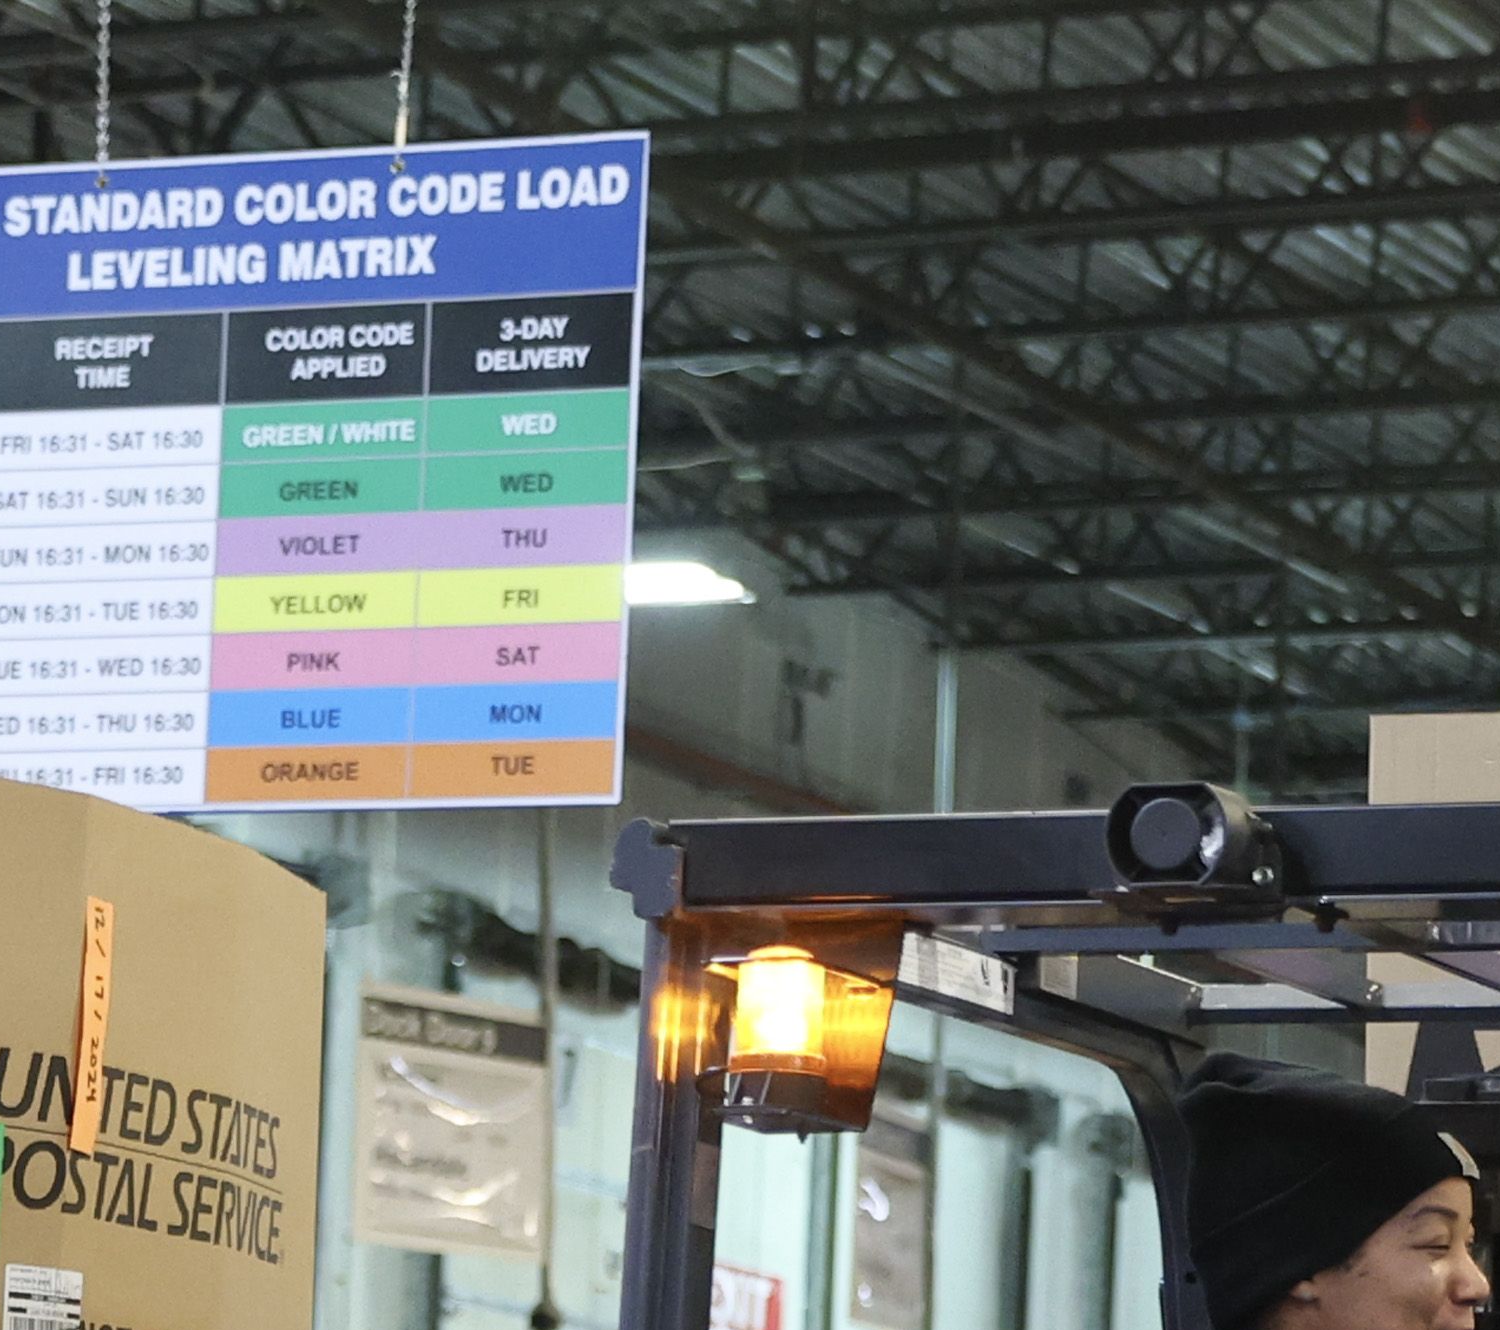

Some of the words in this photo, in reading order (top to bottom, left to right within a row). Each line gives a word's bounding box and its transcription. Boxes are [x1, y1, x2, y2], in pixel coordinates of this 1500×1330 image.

[2, 188, 224, 237] STANDARD
[234, 179, 377, 226] COLOR
[388, 171, 505, 217] CODE
[516, 164, 630, 210] LOAD
[65, 243, 267, 292] LEVELING
[278, 234, 437, 282] MATRIX
[265, 326, 344, 352] COLOR
[349, 323, 414, 348] CODE
[499, 316, 570, 342] 3-DAY
[54, 335, 154, 361] RECEIPT
[475, 346, 591, 373] DELIVERY
[74, 365, 131, 389] TIME
[290, 354, 386, 381] APPLIED
[242, 425, 324, 449] GREEN
[342, 419, 416, 445] WHITE
[501, 413, 557, 436] WED
[0, 435, 31, 455] FRI
[39, 433, 87, 454] 16:31
[107, 431, 144, 451] SAT
[153, 429, 203, 450] 16:30
[278, 480, 359, 502] GREEN
[500, 473, 554, 494] WED
[37, 490, 85, 510] 16:31
[105, 488, 146, 507] SUN
[154, 486, 204, 506] 16:30
[279, 534, 360, 557] VIOLET
[501, 528, 548, 549] THU
[36, 546, 84, 566] 16:31
[104, 545, 151, 564] MON
[159, 543, 209, 562] 16:30
[270, 593, 367, 615] YELLOW
[503, 588, 540, 609] FRI
[33, 604, 81, 622] 16:31
[101, 602, 139, 621] TUE
[148, 601, 198, 619] 16:30
[30, 660, 78, 679] 16:31
[98, 658, 143, 678] WED
[152, 656, 202, 676] 16:30
[286, 652, 341, 672] PINK
[496, 646, 540, 667] SAT
[28, 715, 76, 734] 16:31
[97, 714, 136, 733] THU
[144, 712, 194, 732] 16:30
[280, 708, 342, 730] BLUE
[490, 703, 542, 725] MON
[92, 766, 125, 785] FRI
[133, 766, 183, 785] 16:30
[261, 761, 360, 784] ORANGE
[491, 755, 535, 777] TUE
